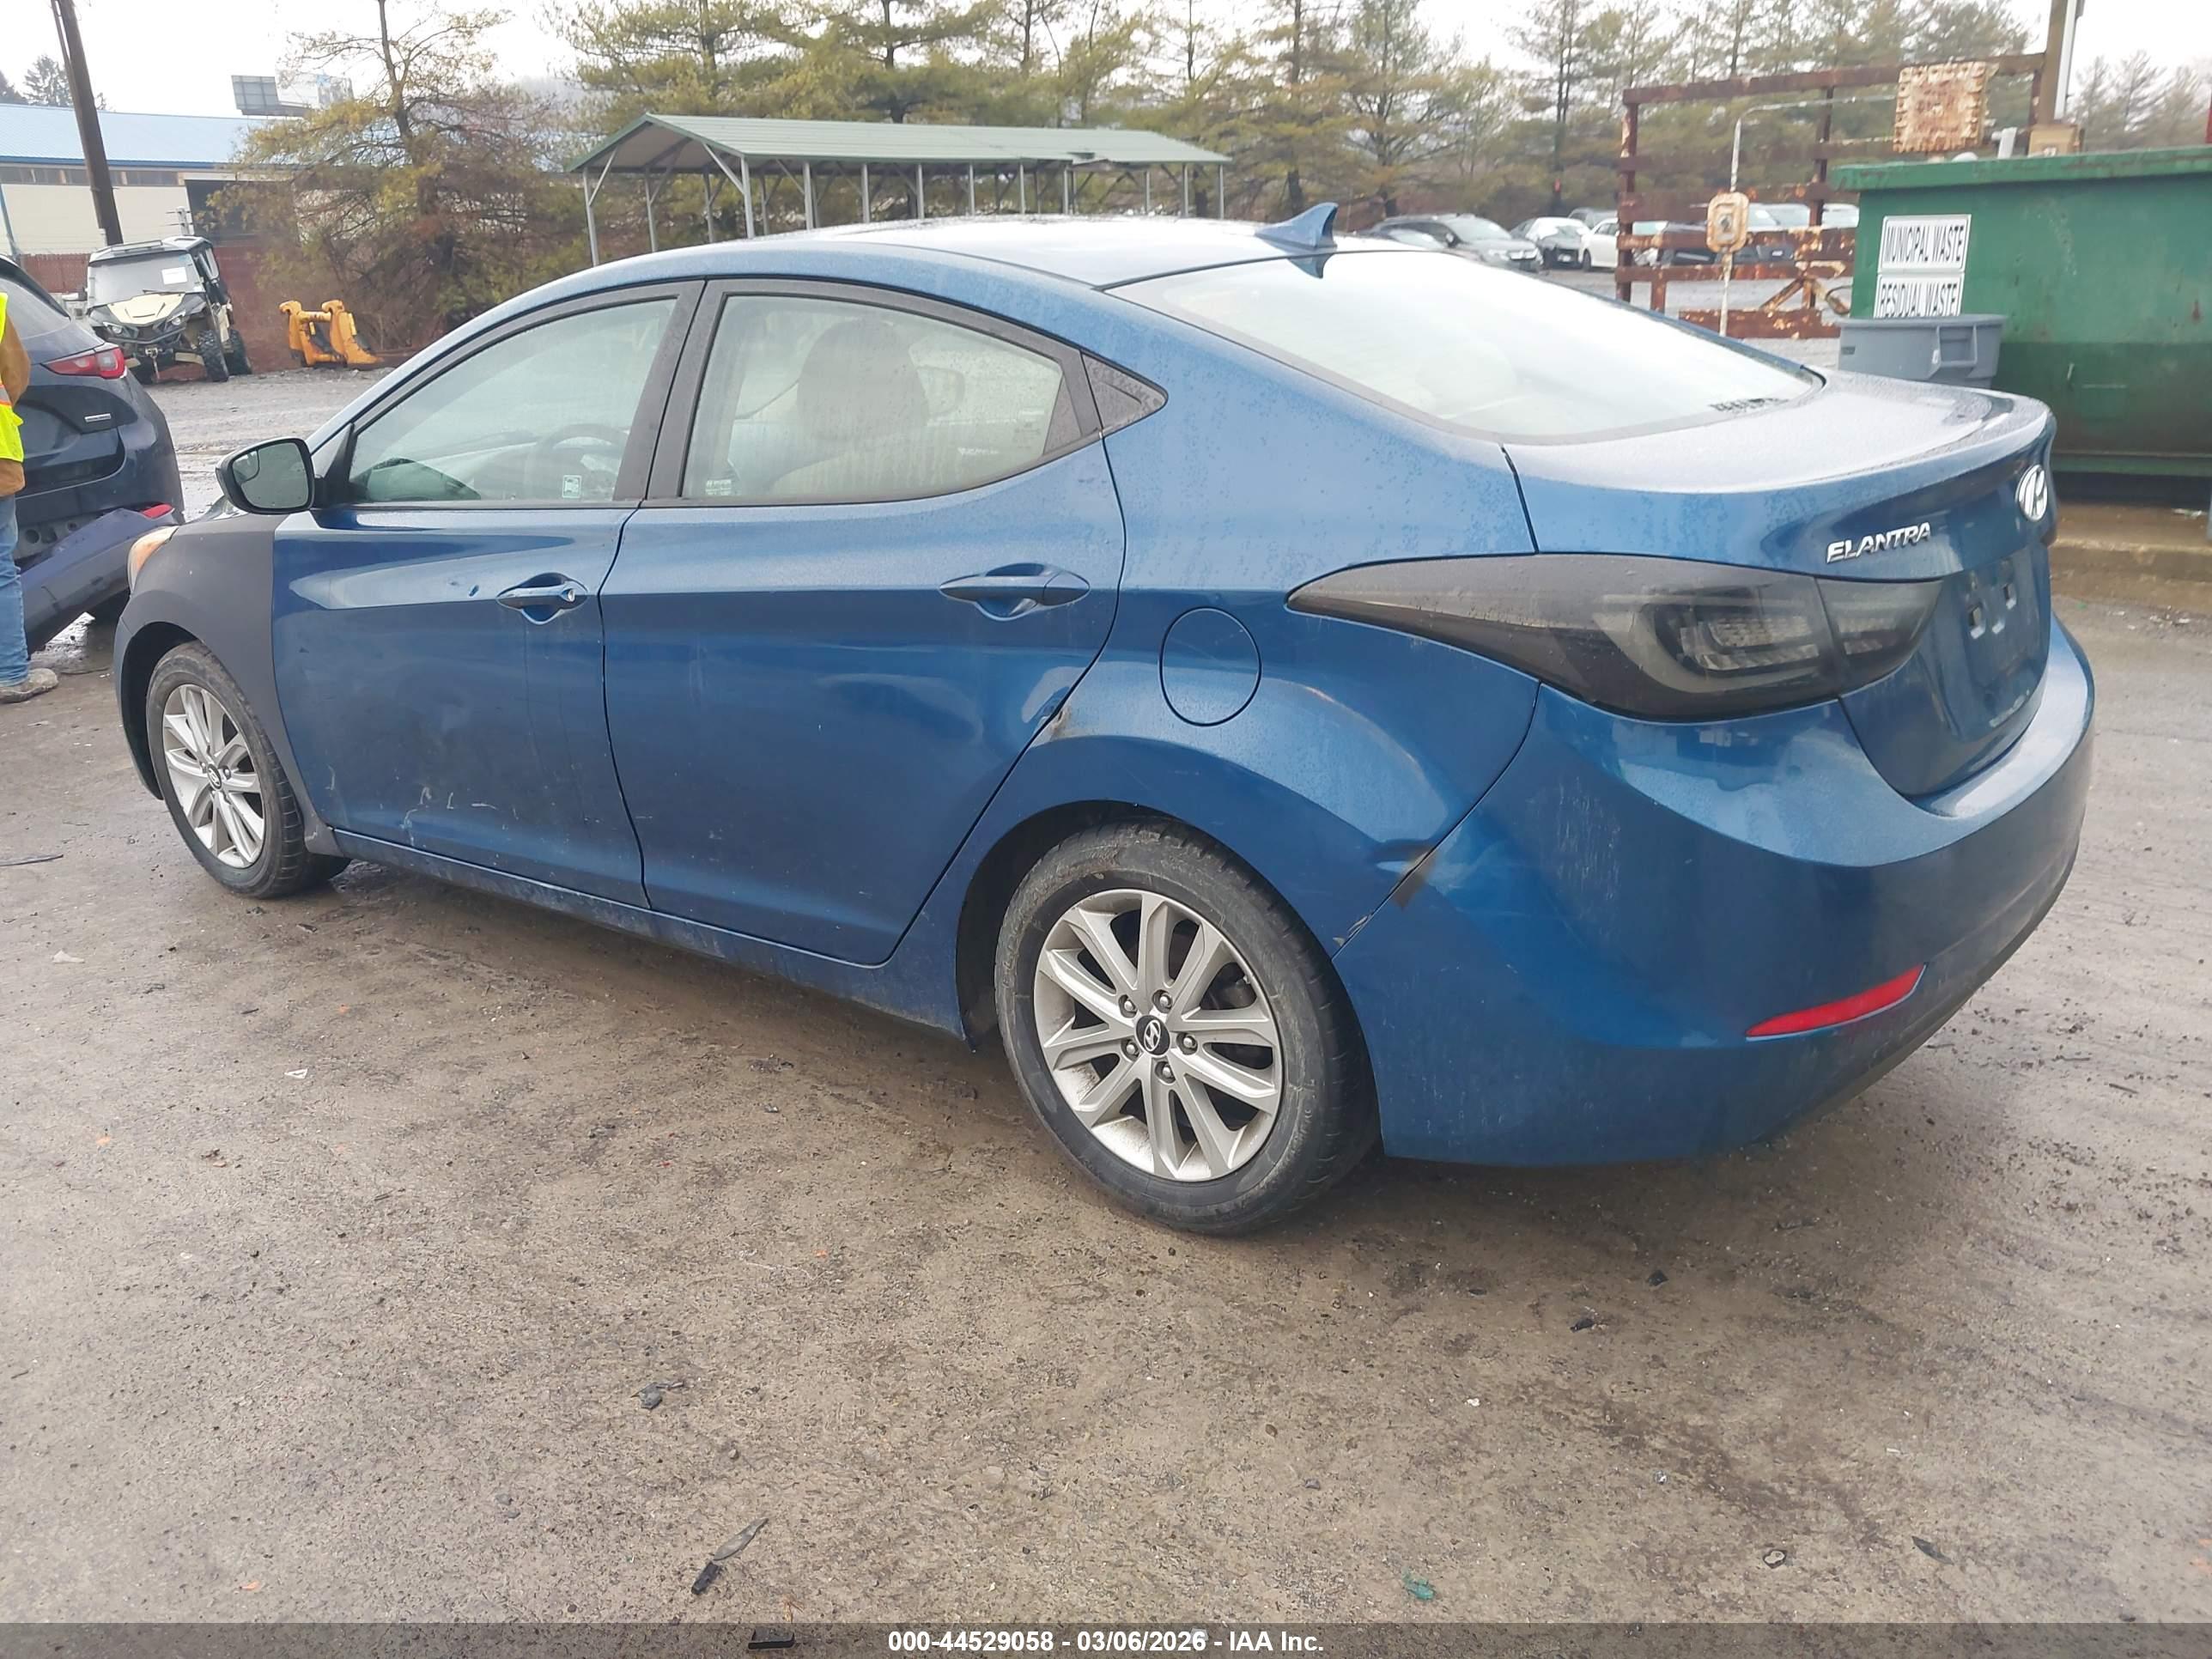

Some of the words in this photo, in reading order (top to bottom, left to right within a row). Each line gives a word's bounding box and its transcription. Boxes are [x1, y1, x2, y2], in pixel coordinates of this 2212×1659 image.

[1884, 226, 1930, 262] MUNICIPAL
[1932, 225, 1965, 262] WASTE
[1879, 283, 1923, 318] RESIDUAL
[1924, 283, 1958, 317] WASTE
[1826, 521, 1931, 563] ELANTRA
